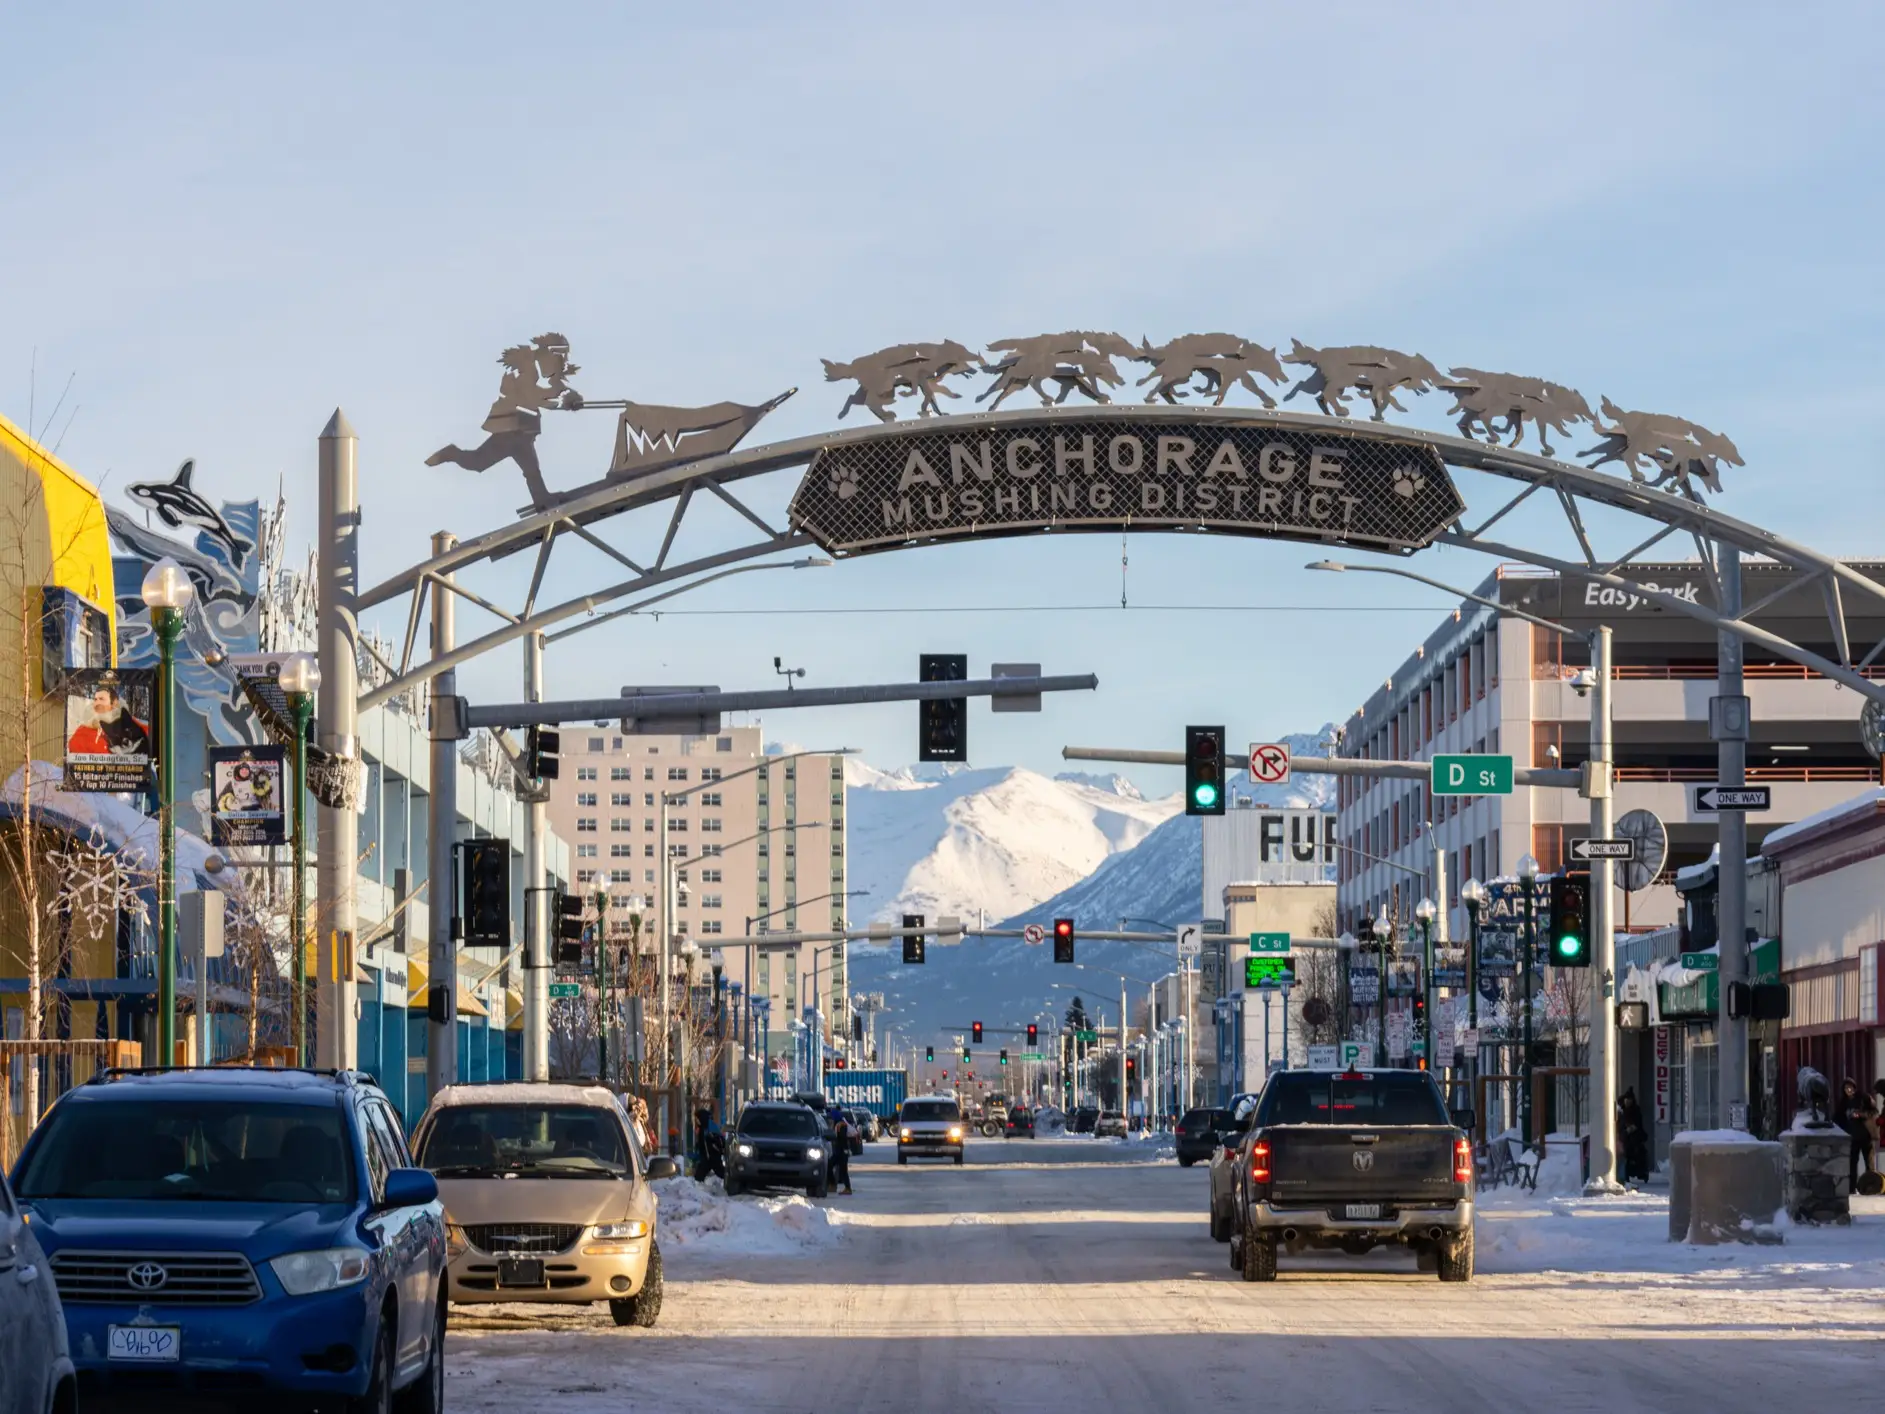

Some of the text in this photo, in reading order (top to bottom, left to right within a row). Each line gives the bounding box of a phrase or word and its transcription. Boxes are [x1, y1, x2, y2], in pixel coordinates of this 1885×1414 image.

[898, 434, 1347, 492] ANCHORAGE
[882, 483, 1362, 528] MUSHING DISTRICT
[1585, 582, 1699, 611] EasyPrk
[1450, 763, 1496, 786] D St
[1718, 794, 1763, 803] ONE WAY
[1589, 844, 1626, 853] ONE WAY
[1259, 936, 1282, 948] C St
[1687, 956, 1694, 966] D
[553, 986, 559, 994] D
[825, 1085, 883, 1103] LASKA
[1656, 1065, 1668, 1120] DELI
